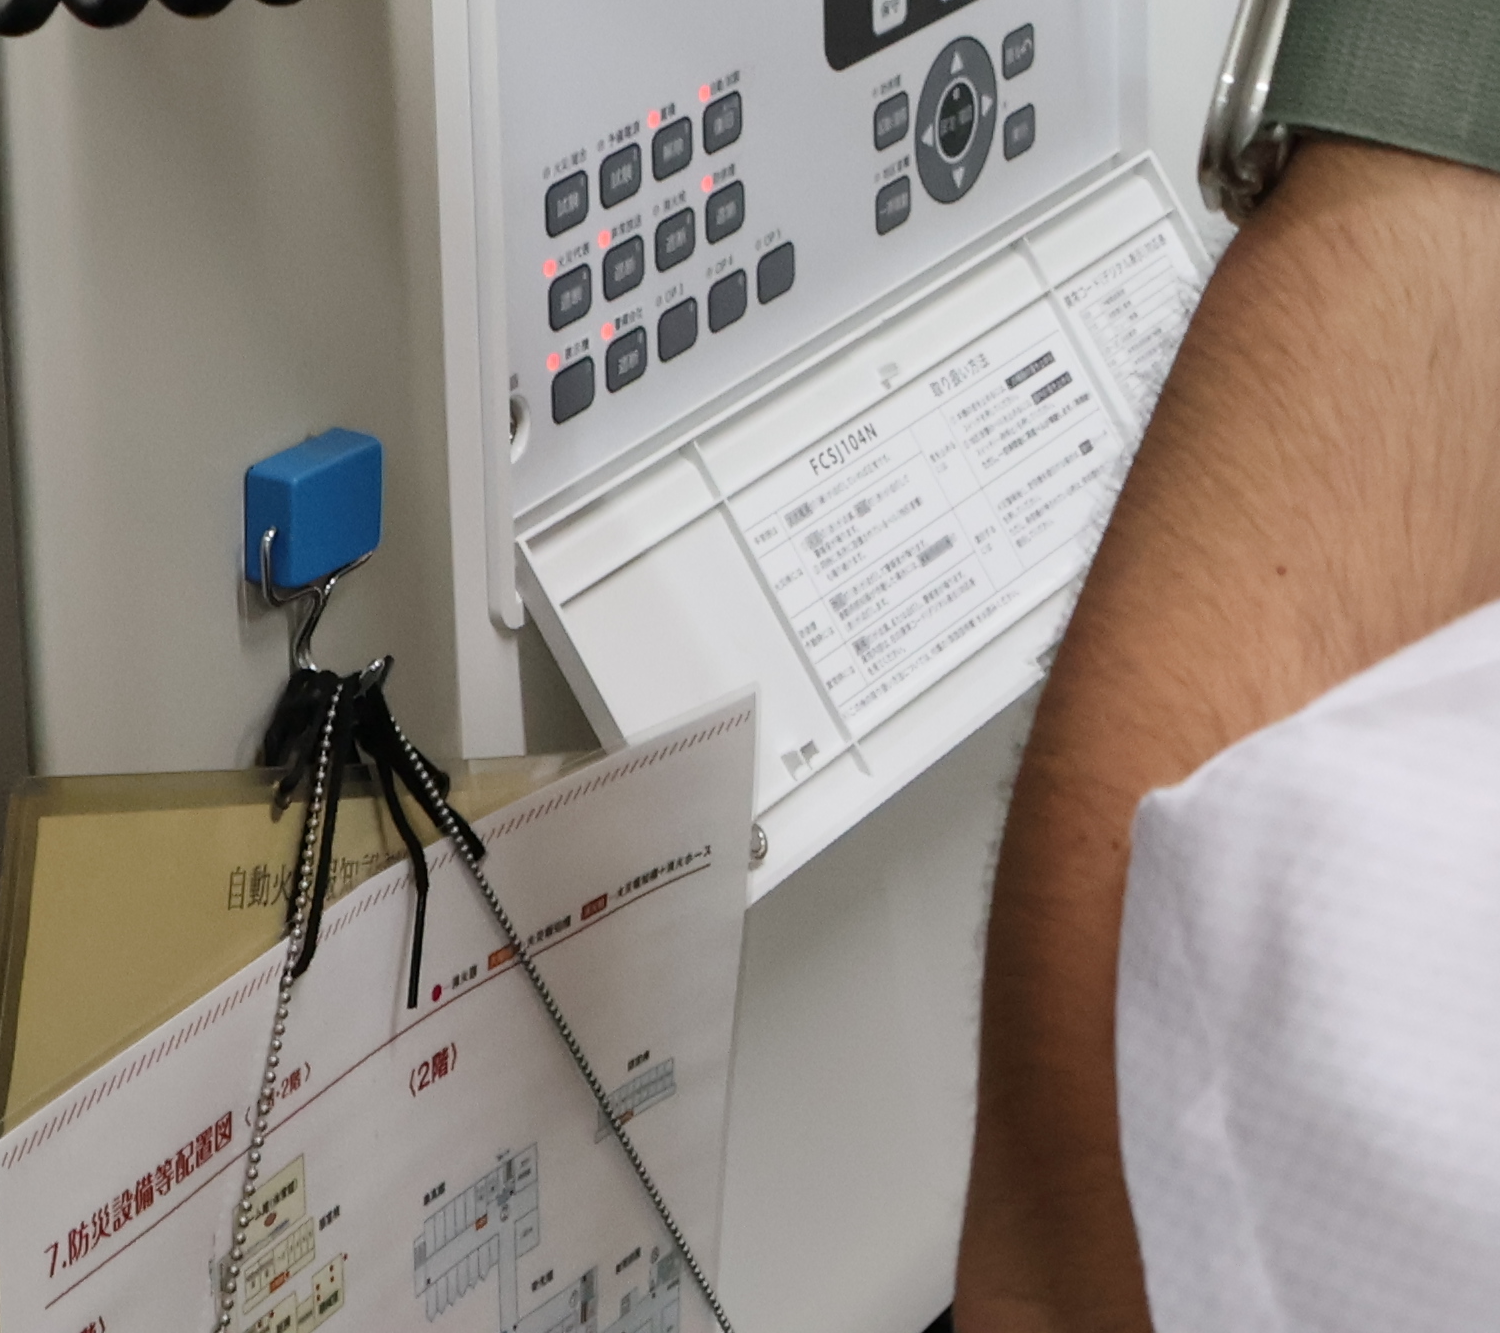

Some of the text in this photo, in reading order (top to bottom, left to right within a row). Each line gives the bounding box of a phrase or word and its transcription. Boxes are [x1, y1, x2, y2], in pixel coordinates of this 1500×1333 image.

[810, 423, 879, 475] FCSJ104N
[44, 1110, 232, 1278] 7.防災設備等配置図
